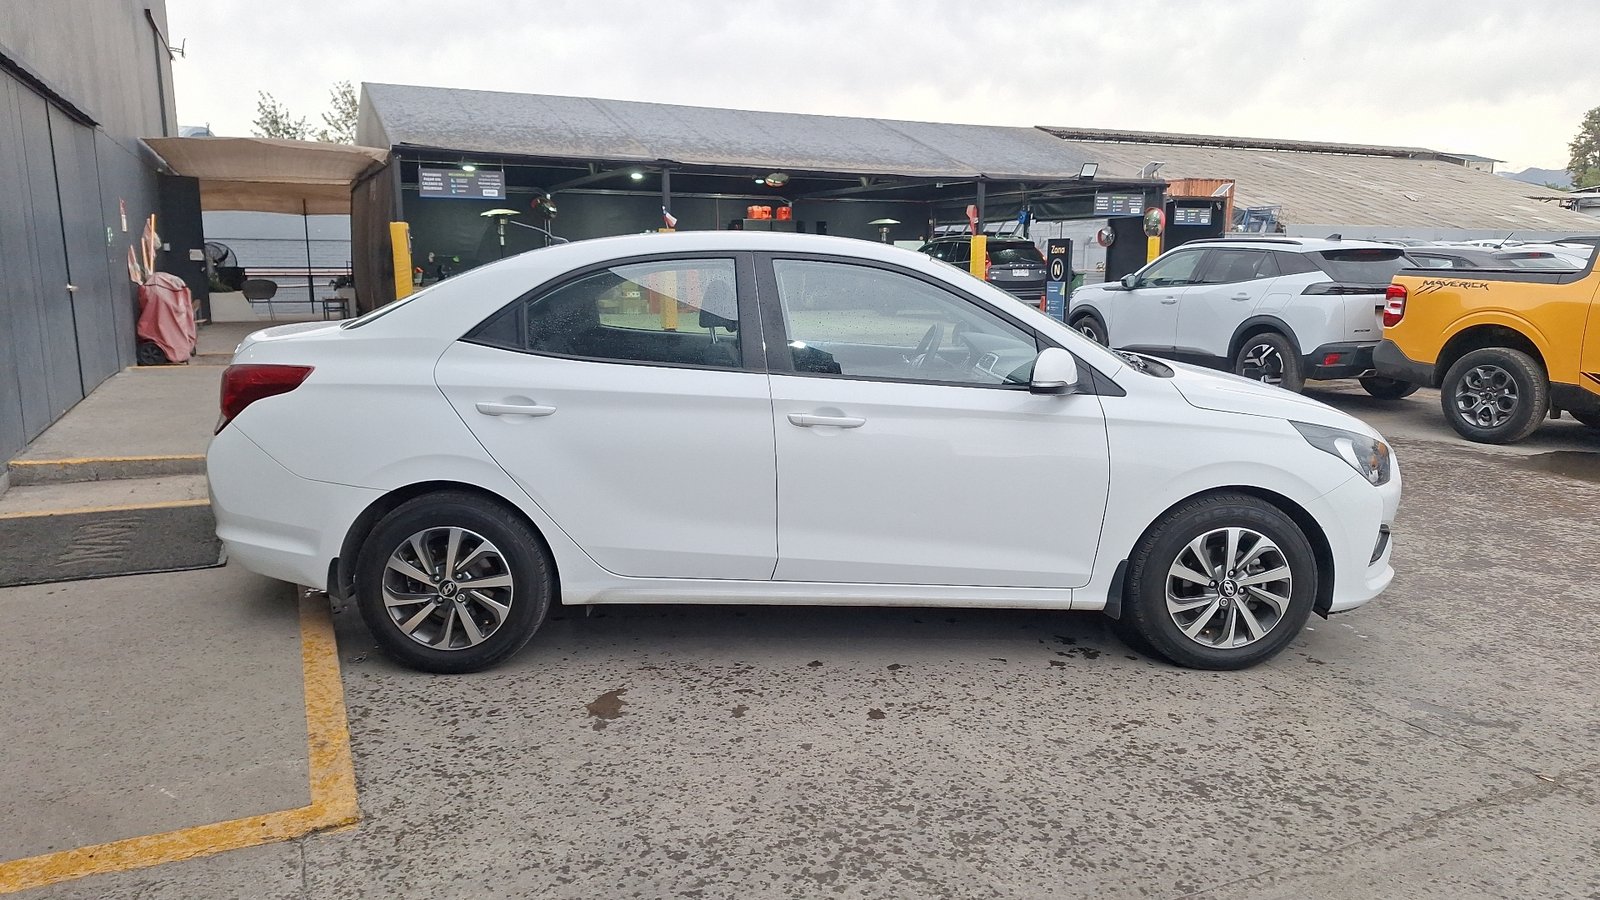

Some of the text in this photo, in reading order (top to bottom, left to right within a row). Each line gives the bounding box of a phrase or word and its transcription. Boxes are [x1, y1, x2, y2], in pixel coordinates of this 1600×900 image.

[1051, 245, 1065, 254] Zona
[1054, 264, 1061, 276] N
[1418, 280, 1489, 293] MAVERICK
